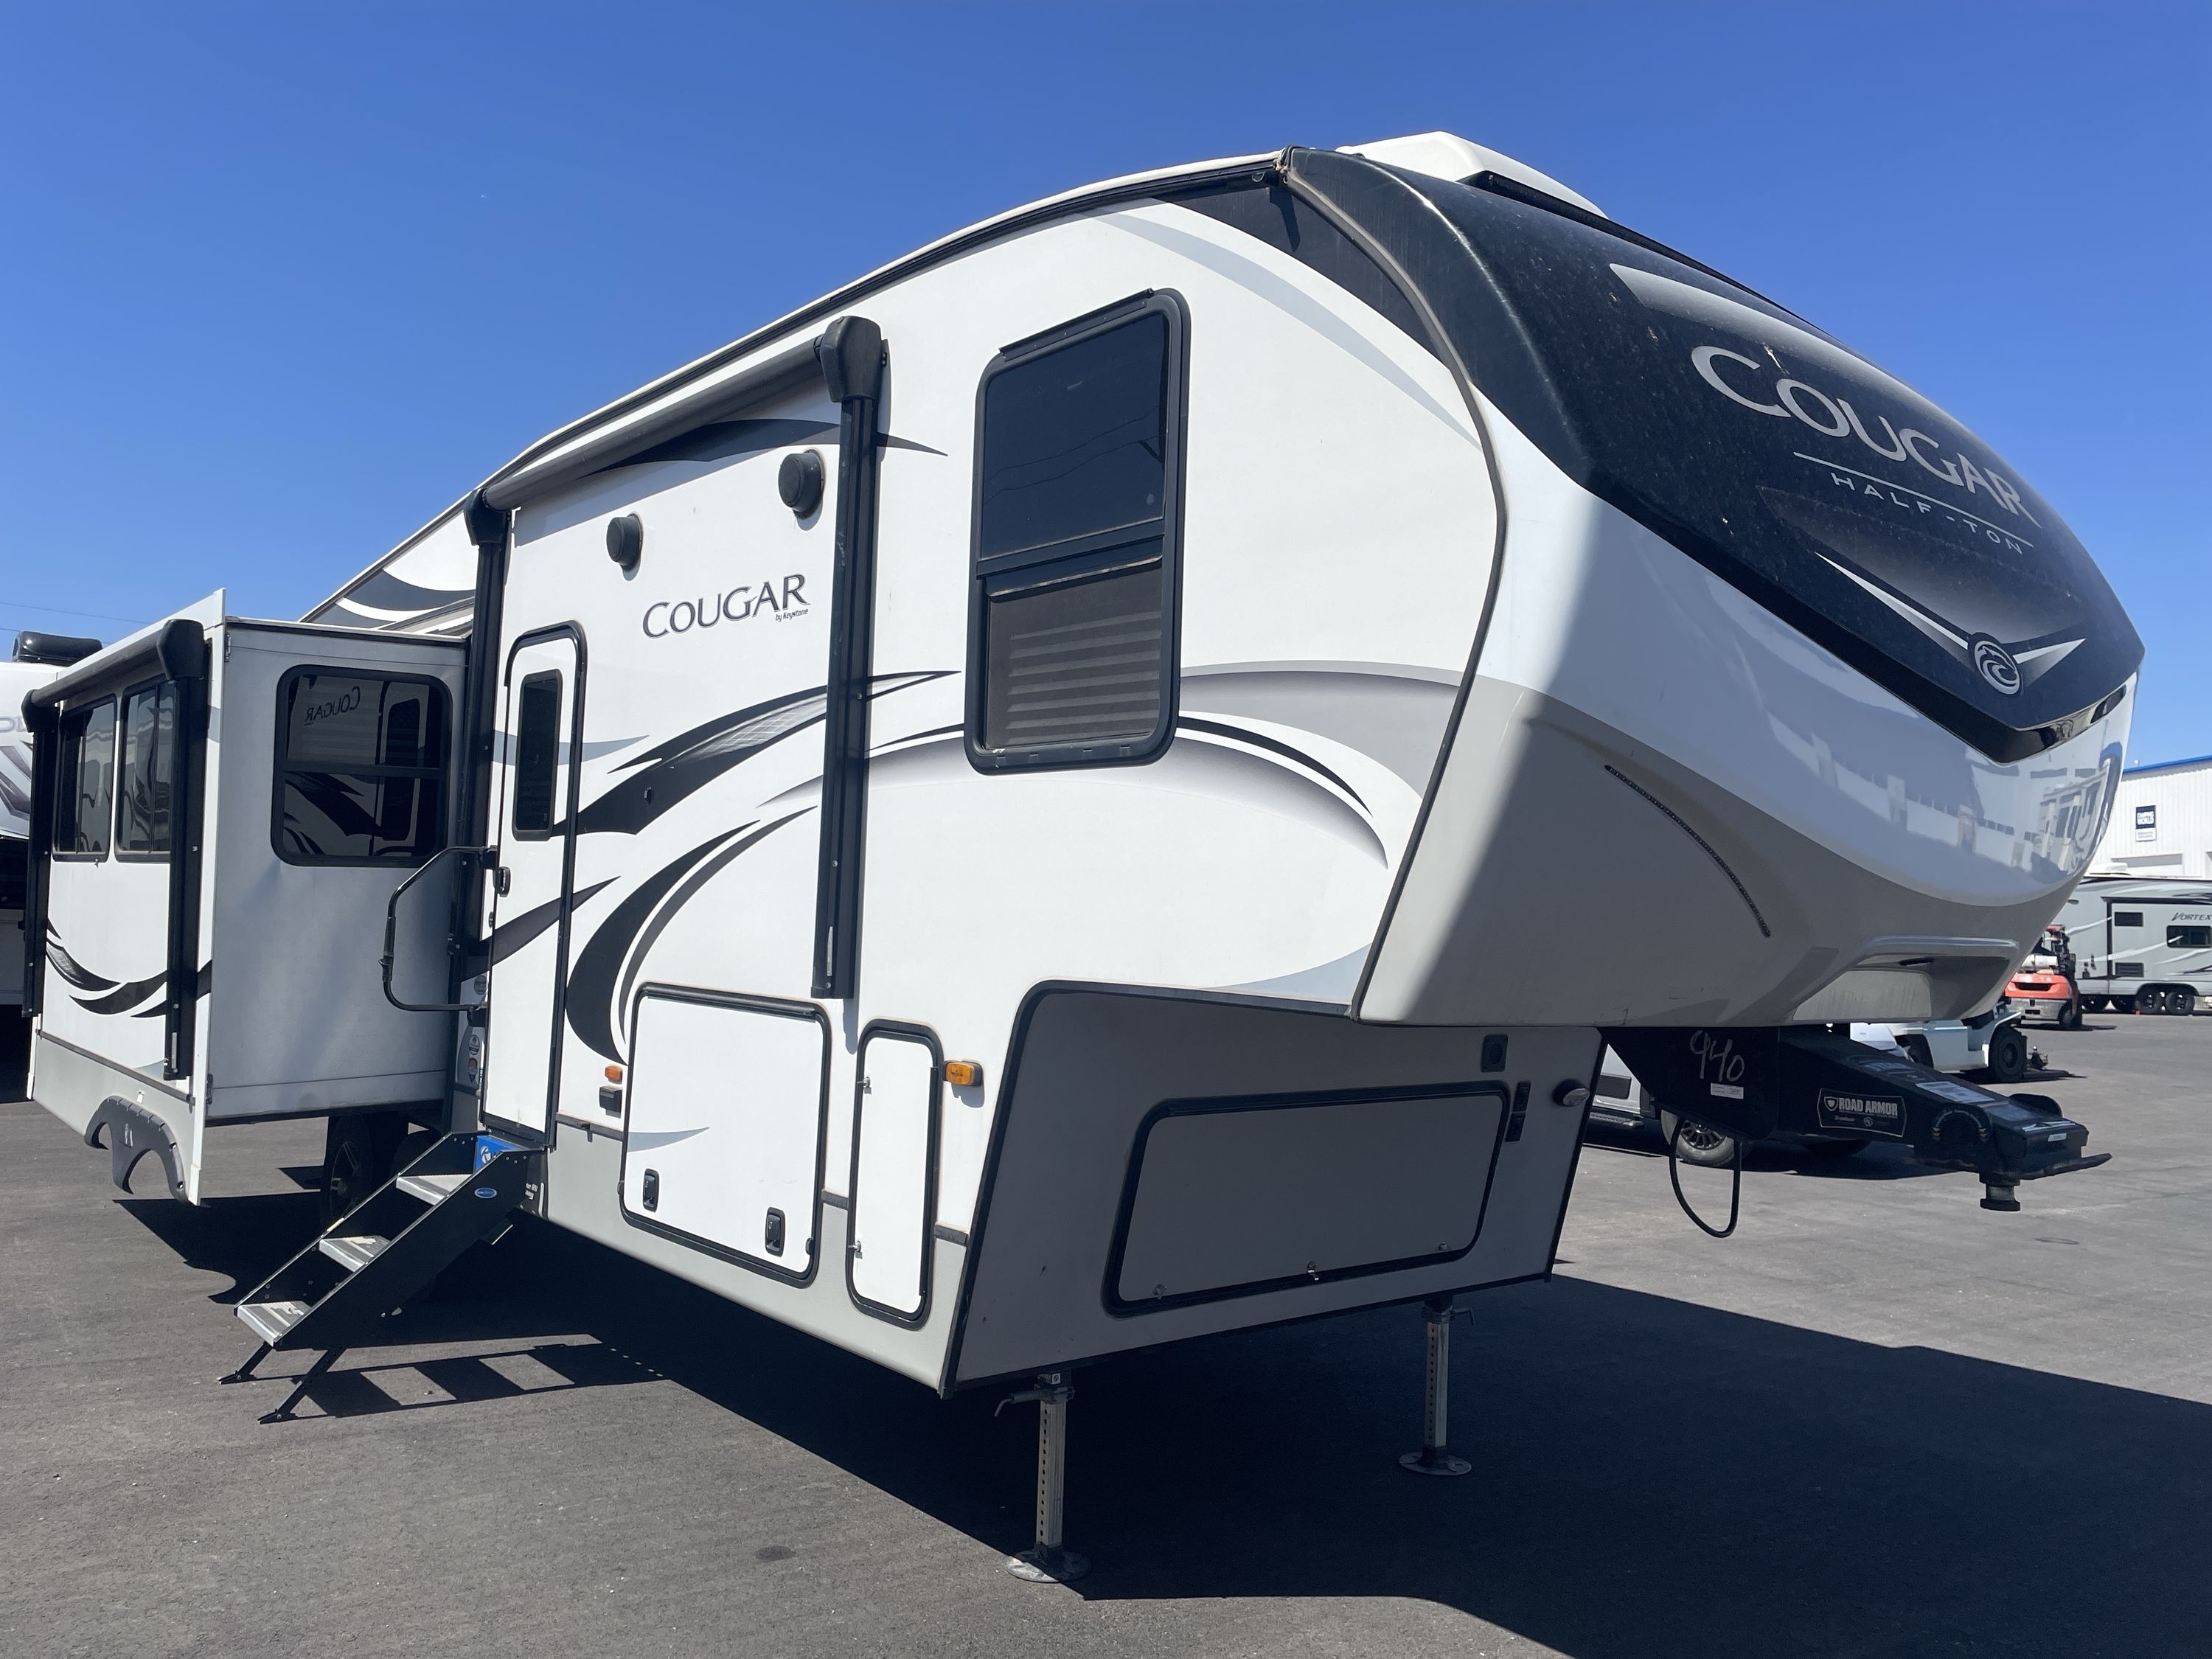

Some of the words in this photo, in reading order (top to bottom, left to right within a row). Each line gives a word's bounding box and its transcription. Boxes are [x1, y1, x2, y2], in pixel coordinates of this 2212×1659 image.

[1691, 344, 2042, 529] COUGAR
[642, 573, 810, 639] COUGAR
[775, 613, 782, 622] by
[783, 608, 809, 620] Keystone
[2171, 911, 2212, 922] VORTEX
[1690, 1030, 1745, 1082] 940
[1838, 1097, 1864, 1112] ROAD
[1865, 1100, 1899, 1116] ARMOR
